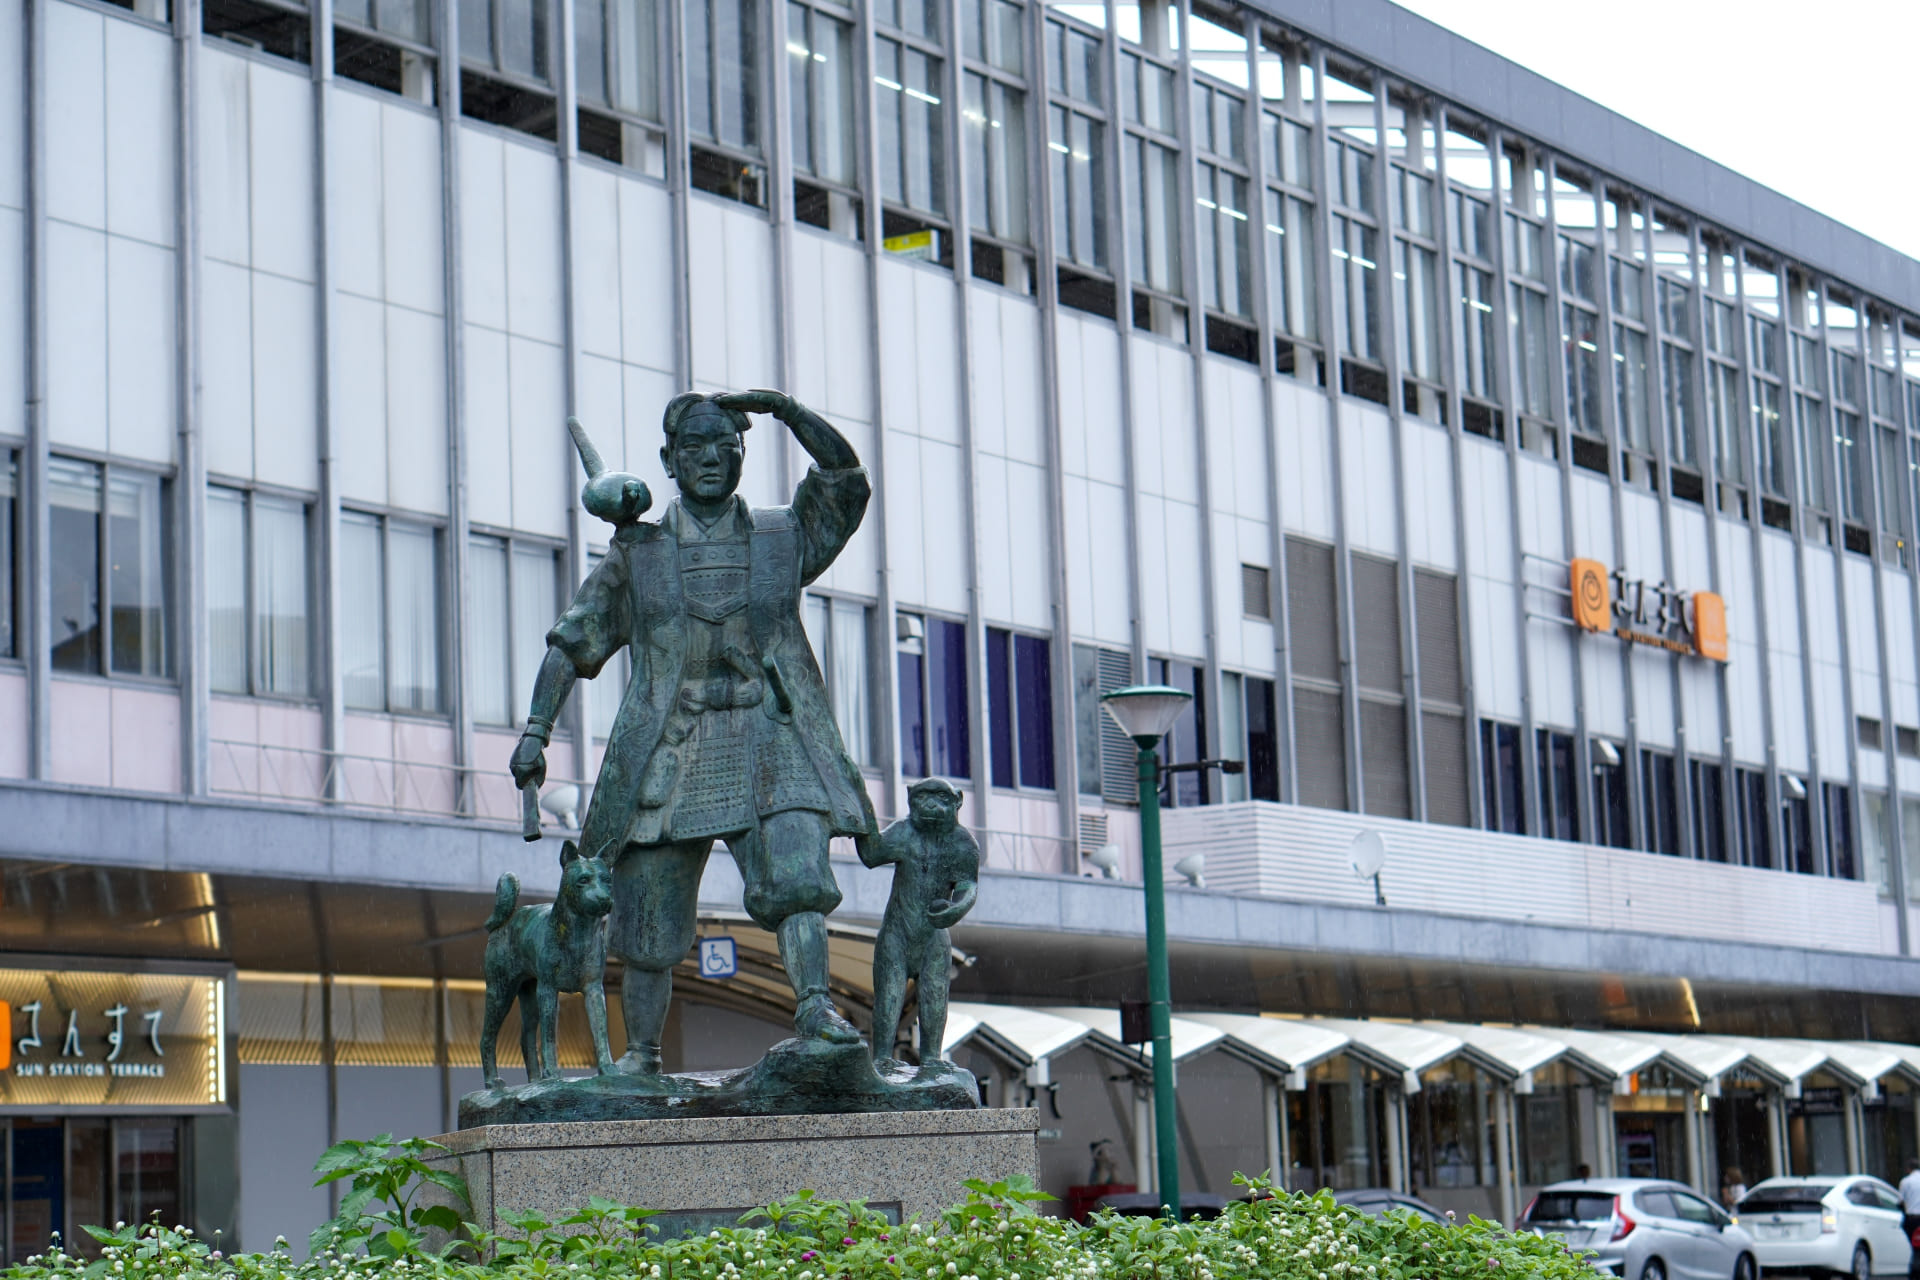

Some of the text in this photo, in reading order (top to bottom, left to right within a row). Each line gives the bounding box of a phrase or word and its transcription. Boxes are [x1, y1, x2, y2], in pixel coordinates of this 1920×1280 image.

[18, 1000, 164, 1062] さんすて
[16, 1063, 165, 1077] SUN STATION TERRACE
